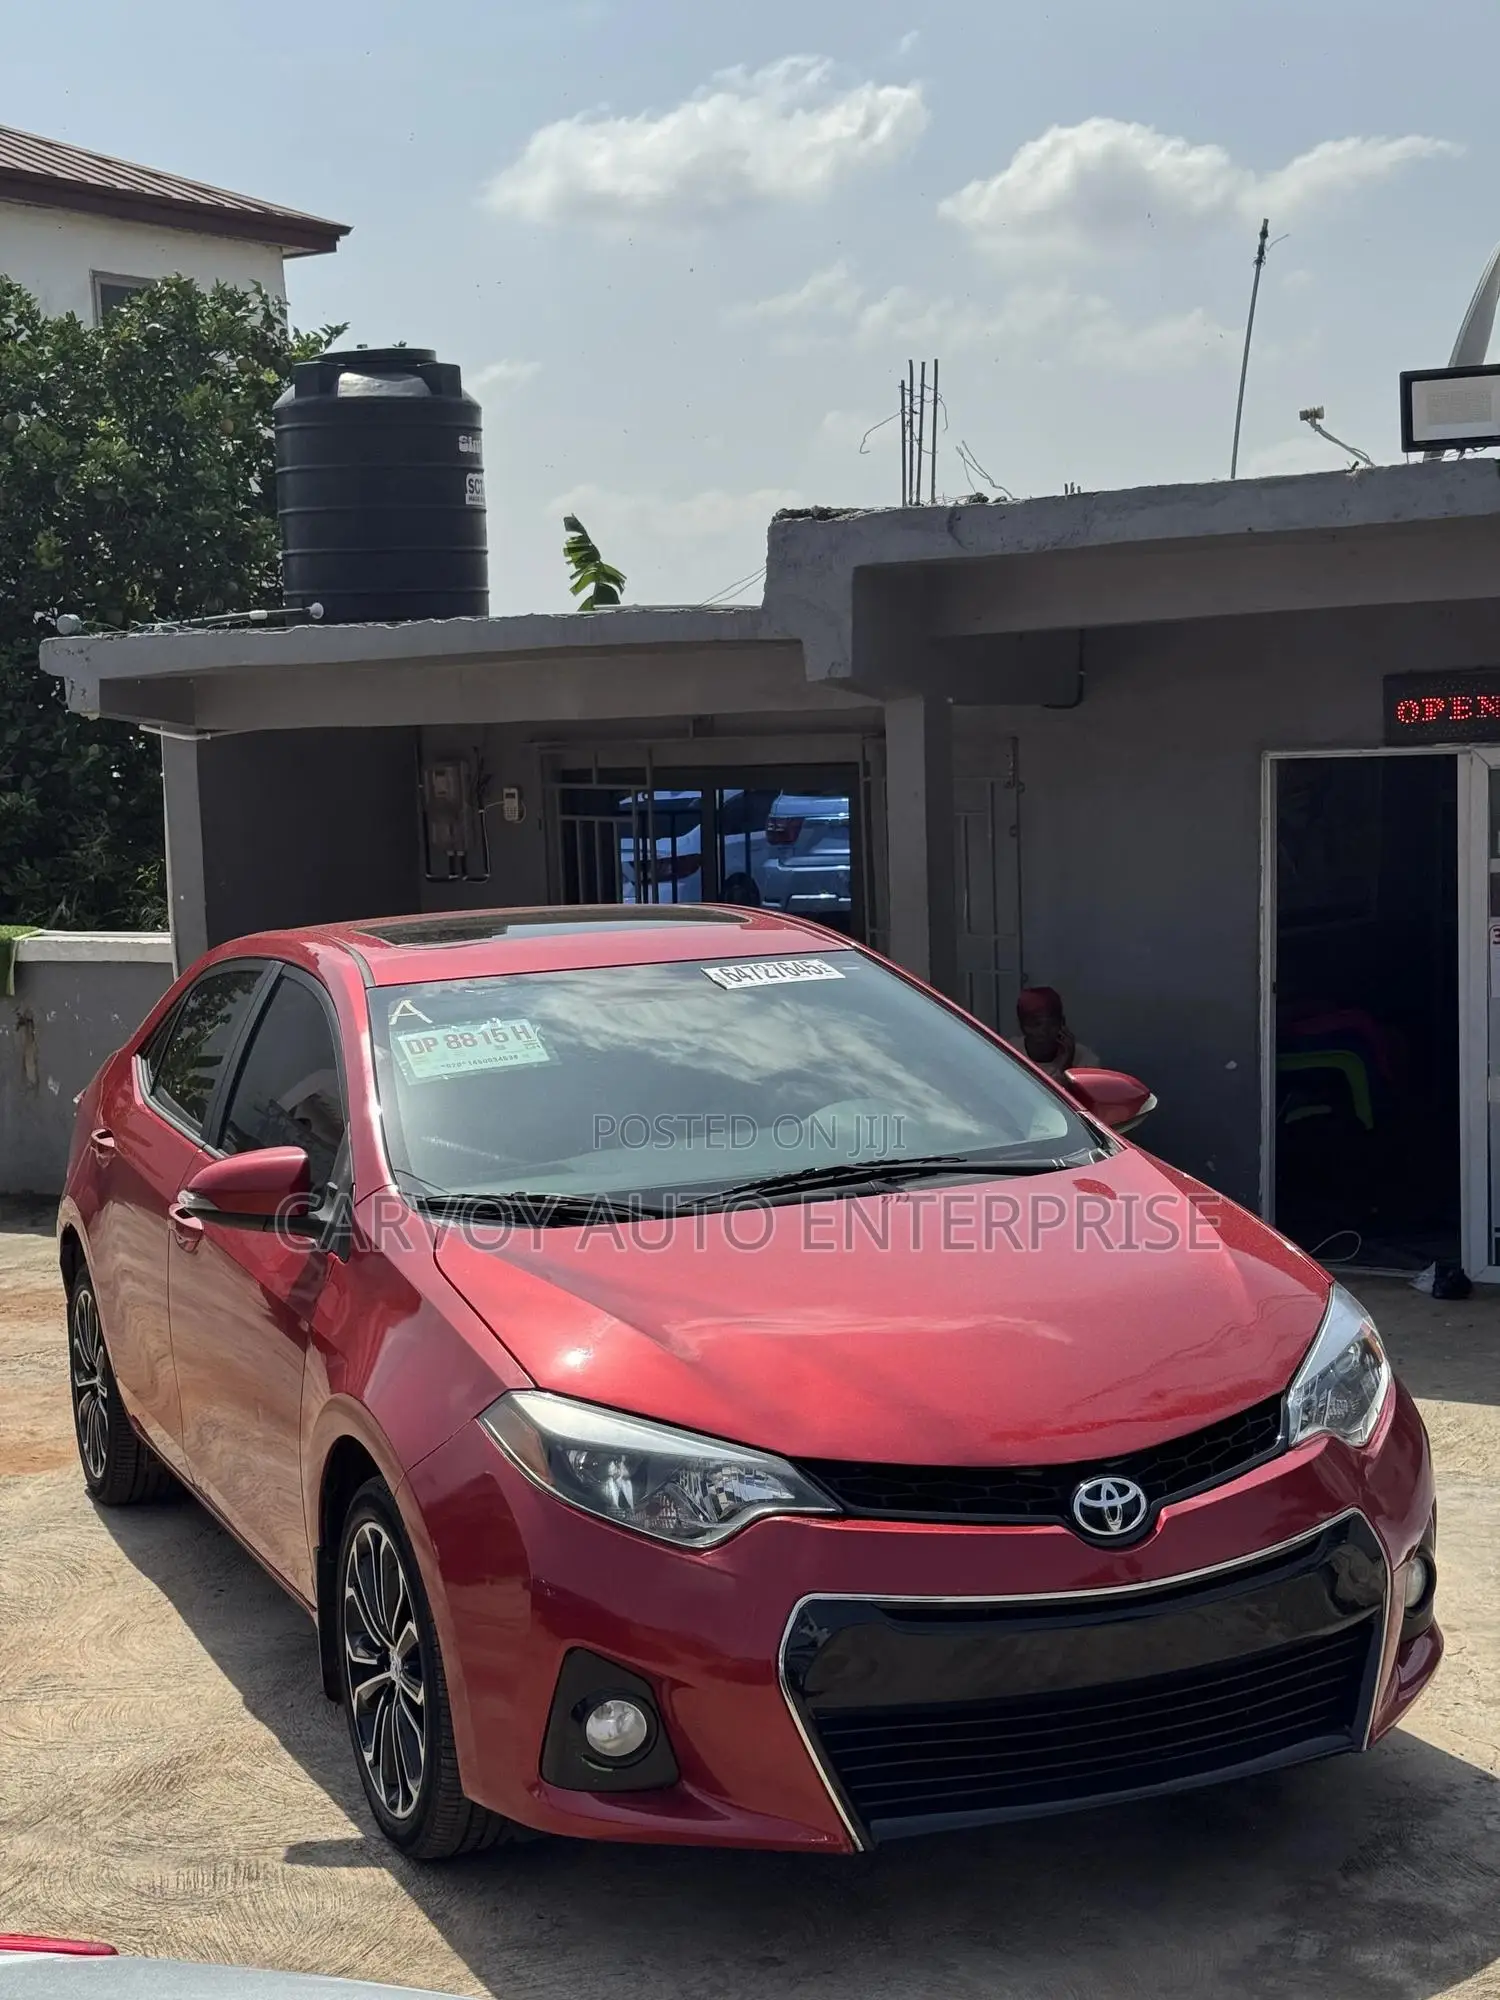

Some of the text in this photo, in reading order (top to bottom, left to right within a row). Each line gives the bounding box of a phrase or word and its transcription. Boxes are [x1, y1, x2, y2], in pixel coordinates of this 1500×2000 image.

[1397, 696, 1500, 723] OPEN
[388, 999, 433, 1025] A
[404, 1037, 439, 1055] DP
[443, 1028, 509, 1050] 8815
[510, 1025, 532, 1041] H
